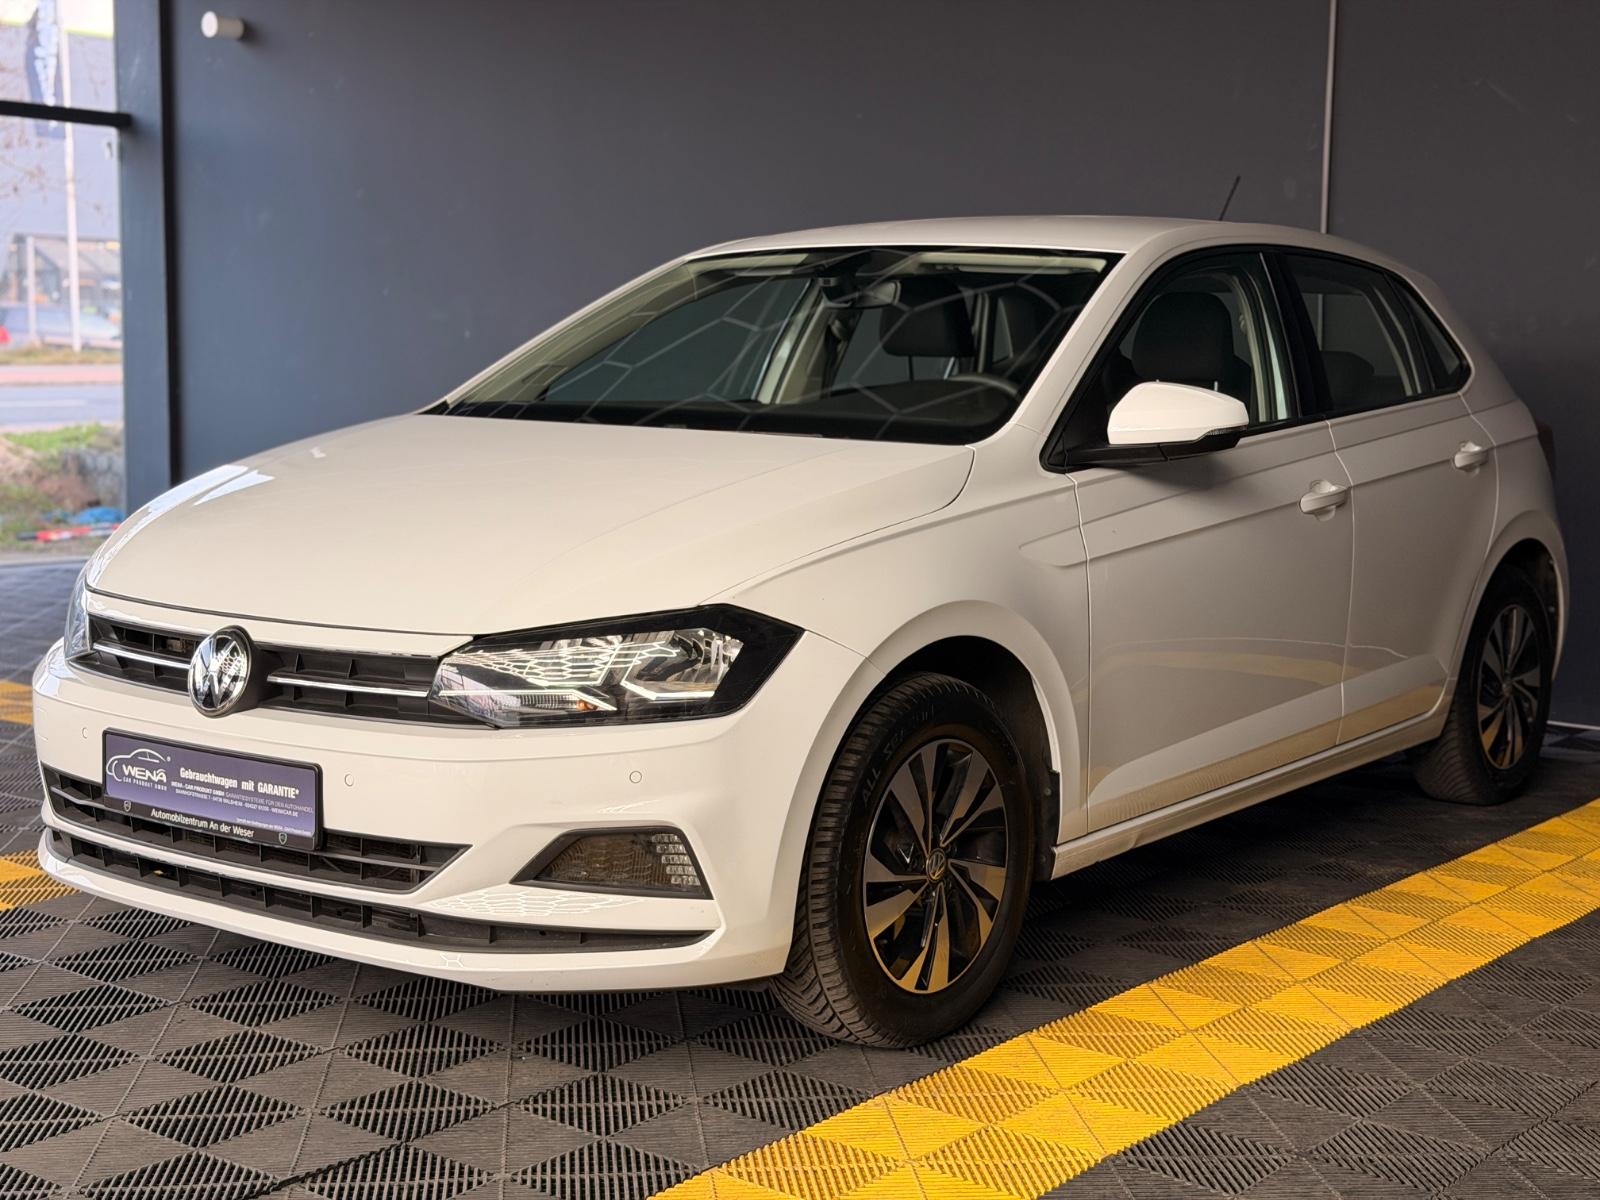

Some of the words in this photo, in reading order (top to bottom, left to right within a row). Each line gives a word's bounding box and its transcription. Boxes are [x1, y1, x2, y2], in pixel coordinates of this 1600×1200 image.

[123, 776, 132, 784] CAR
[180, 767, 238, 788] Gebrauchtwagen
[241, 780, 255, 792] mit
[150, 807, 209, 831] Automobilzentrum
[209, 820, 219, 831] An
[220, 822, 232, 834] der
[232, 824, 255, 838] Weser
